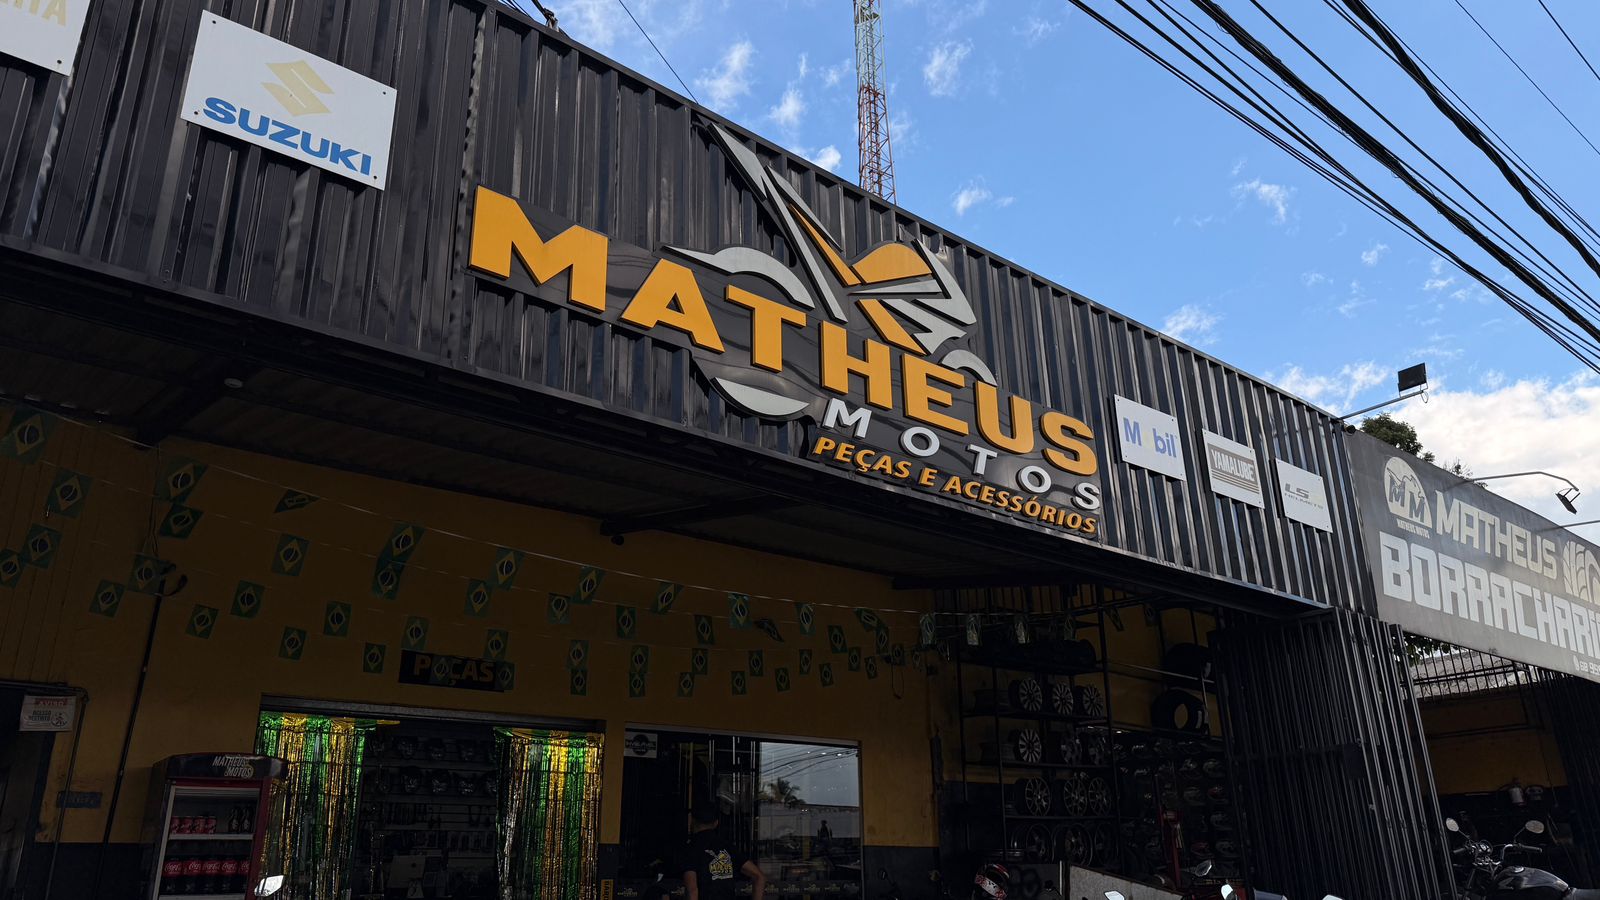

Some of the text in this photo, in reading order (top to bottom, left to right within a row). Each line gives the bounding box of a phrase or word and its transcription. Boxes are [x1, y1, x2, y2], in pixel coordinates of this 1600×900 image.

[203, 97, 371, 176] SUZUKI
[468, 184, 1097, 476] MATHEUS
[822, 397, 1100, 510] MOTOS
[1123, 416, 1177, 458] Mbil
[1210, 449, 1257, 482] YAMALUBE
[812, 436, 1097, 533] PEÇAS E ACESSÓRIOS
[1435, 489, 1557, 580] MATHEUS
[413, 653, 496, 686] PÇAS
